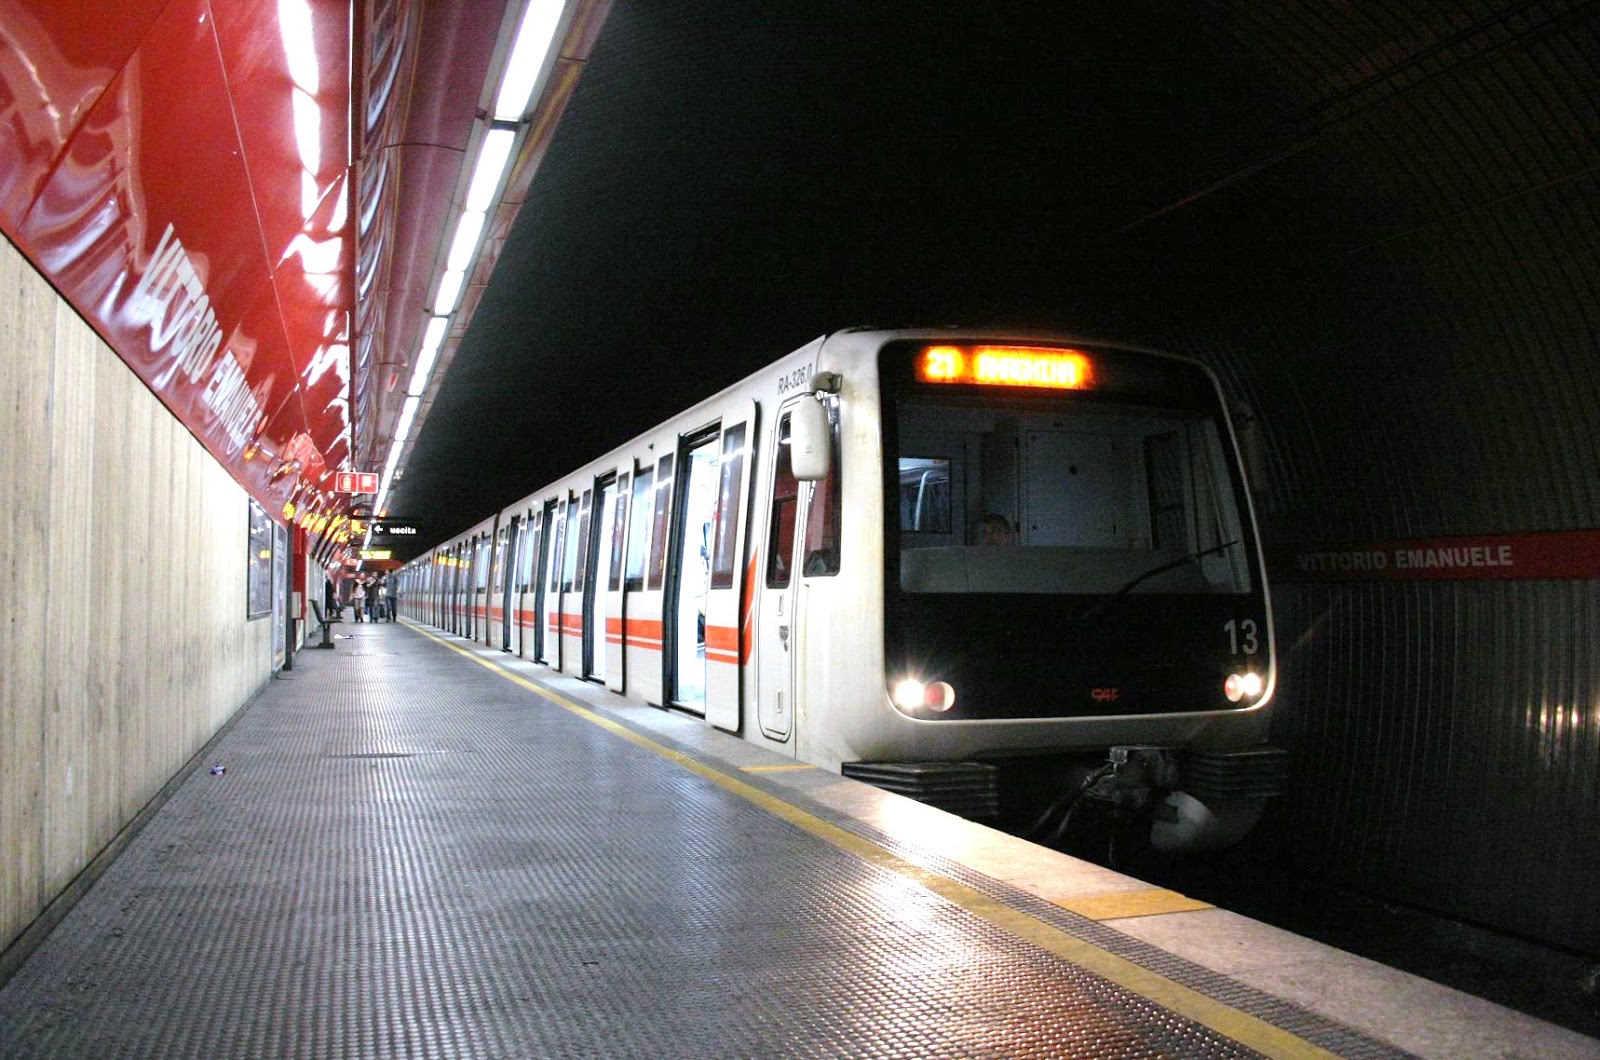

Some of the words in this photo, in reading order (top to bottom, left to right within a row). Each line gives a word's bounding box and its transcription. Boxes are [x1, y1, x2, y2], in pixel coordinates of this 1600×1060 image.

[121, 221, 224, 385] VITTORIO
[202, 349, 263, 450] EMANUELE
[927, 349, 957, 378] 21
[389, 525, 417, 535] uscita
[1299, 550, 1387, 571] VITTORIO
[1396, 545, 1514, 569] EMANUELE
[1223, 618, 1259, 655] 13
